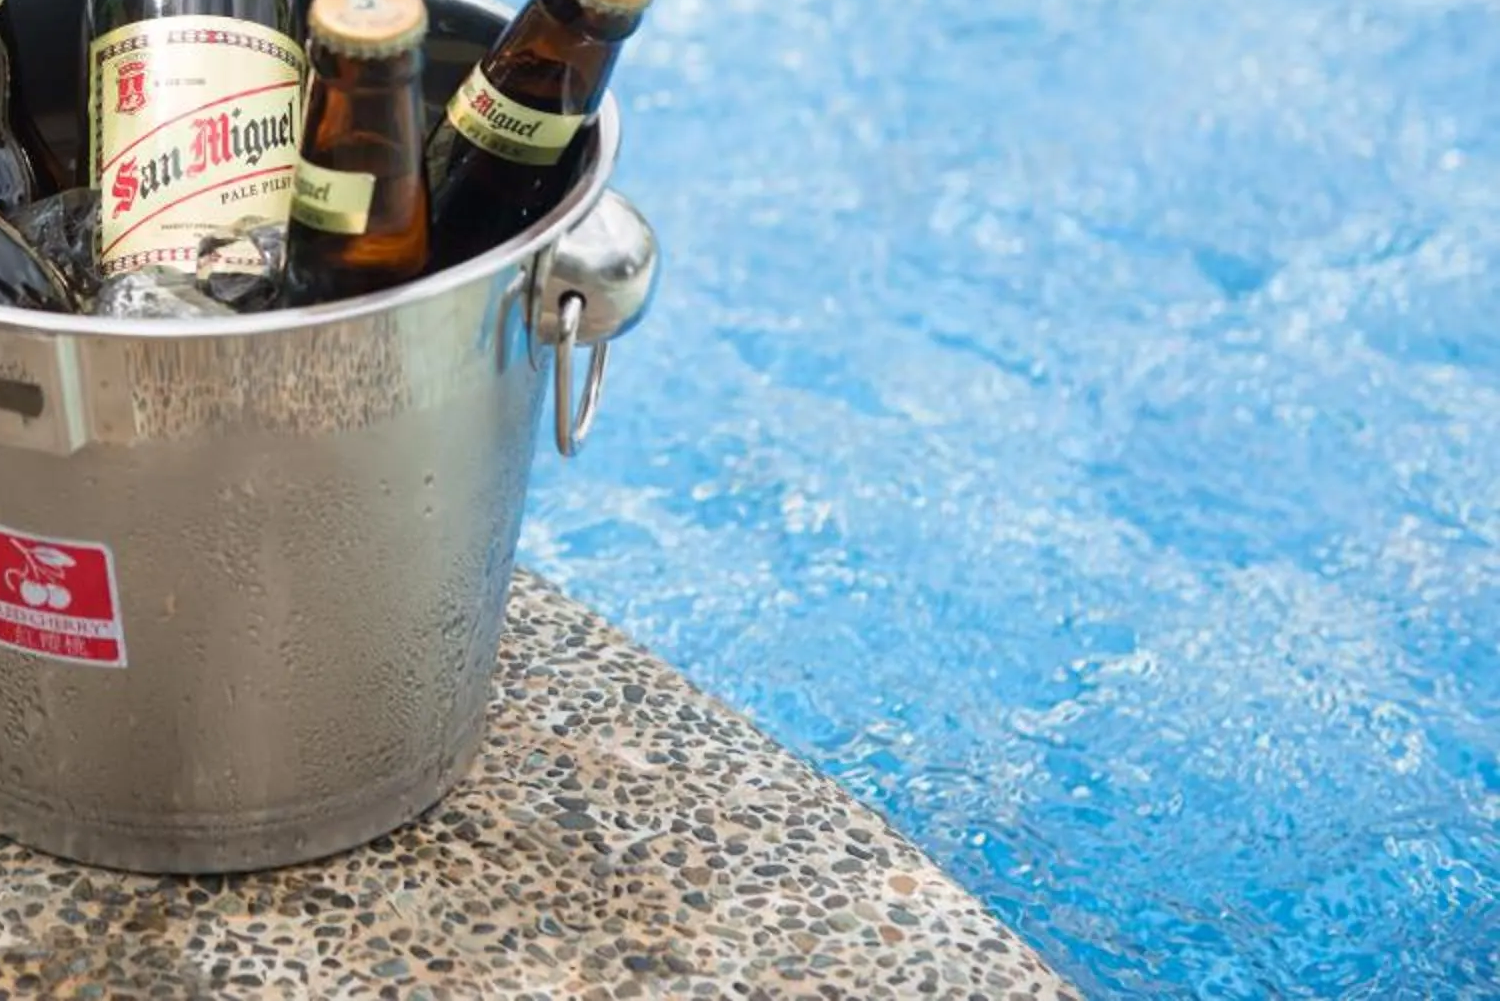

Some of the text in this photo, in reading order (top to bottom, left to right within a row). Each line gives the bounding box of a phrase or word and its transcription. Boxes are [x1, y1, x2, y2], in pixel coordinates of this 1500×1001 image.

[469, 88, 543, 139] Miguel
[111, 97, 296, 220] San Miguel
[220, 183, 258, 205] PALE
